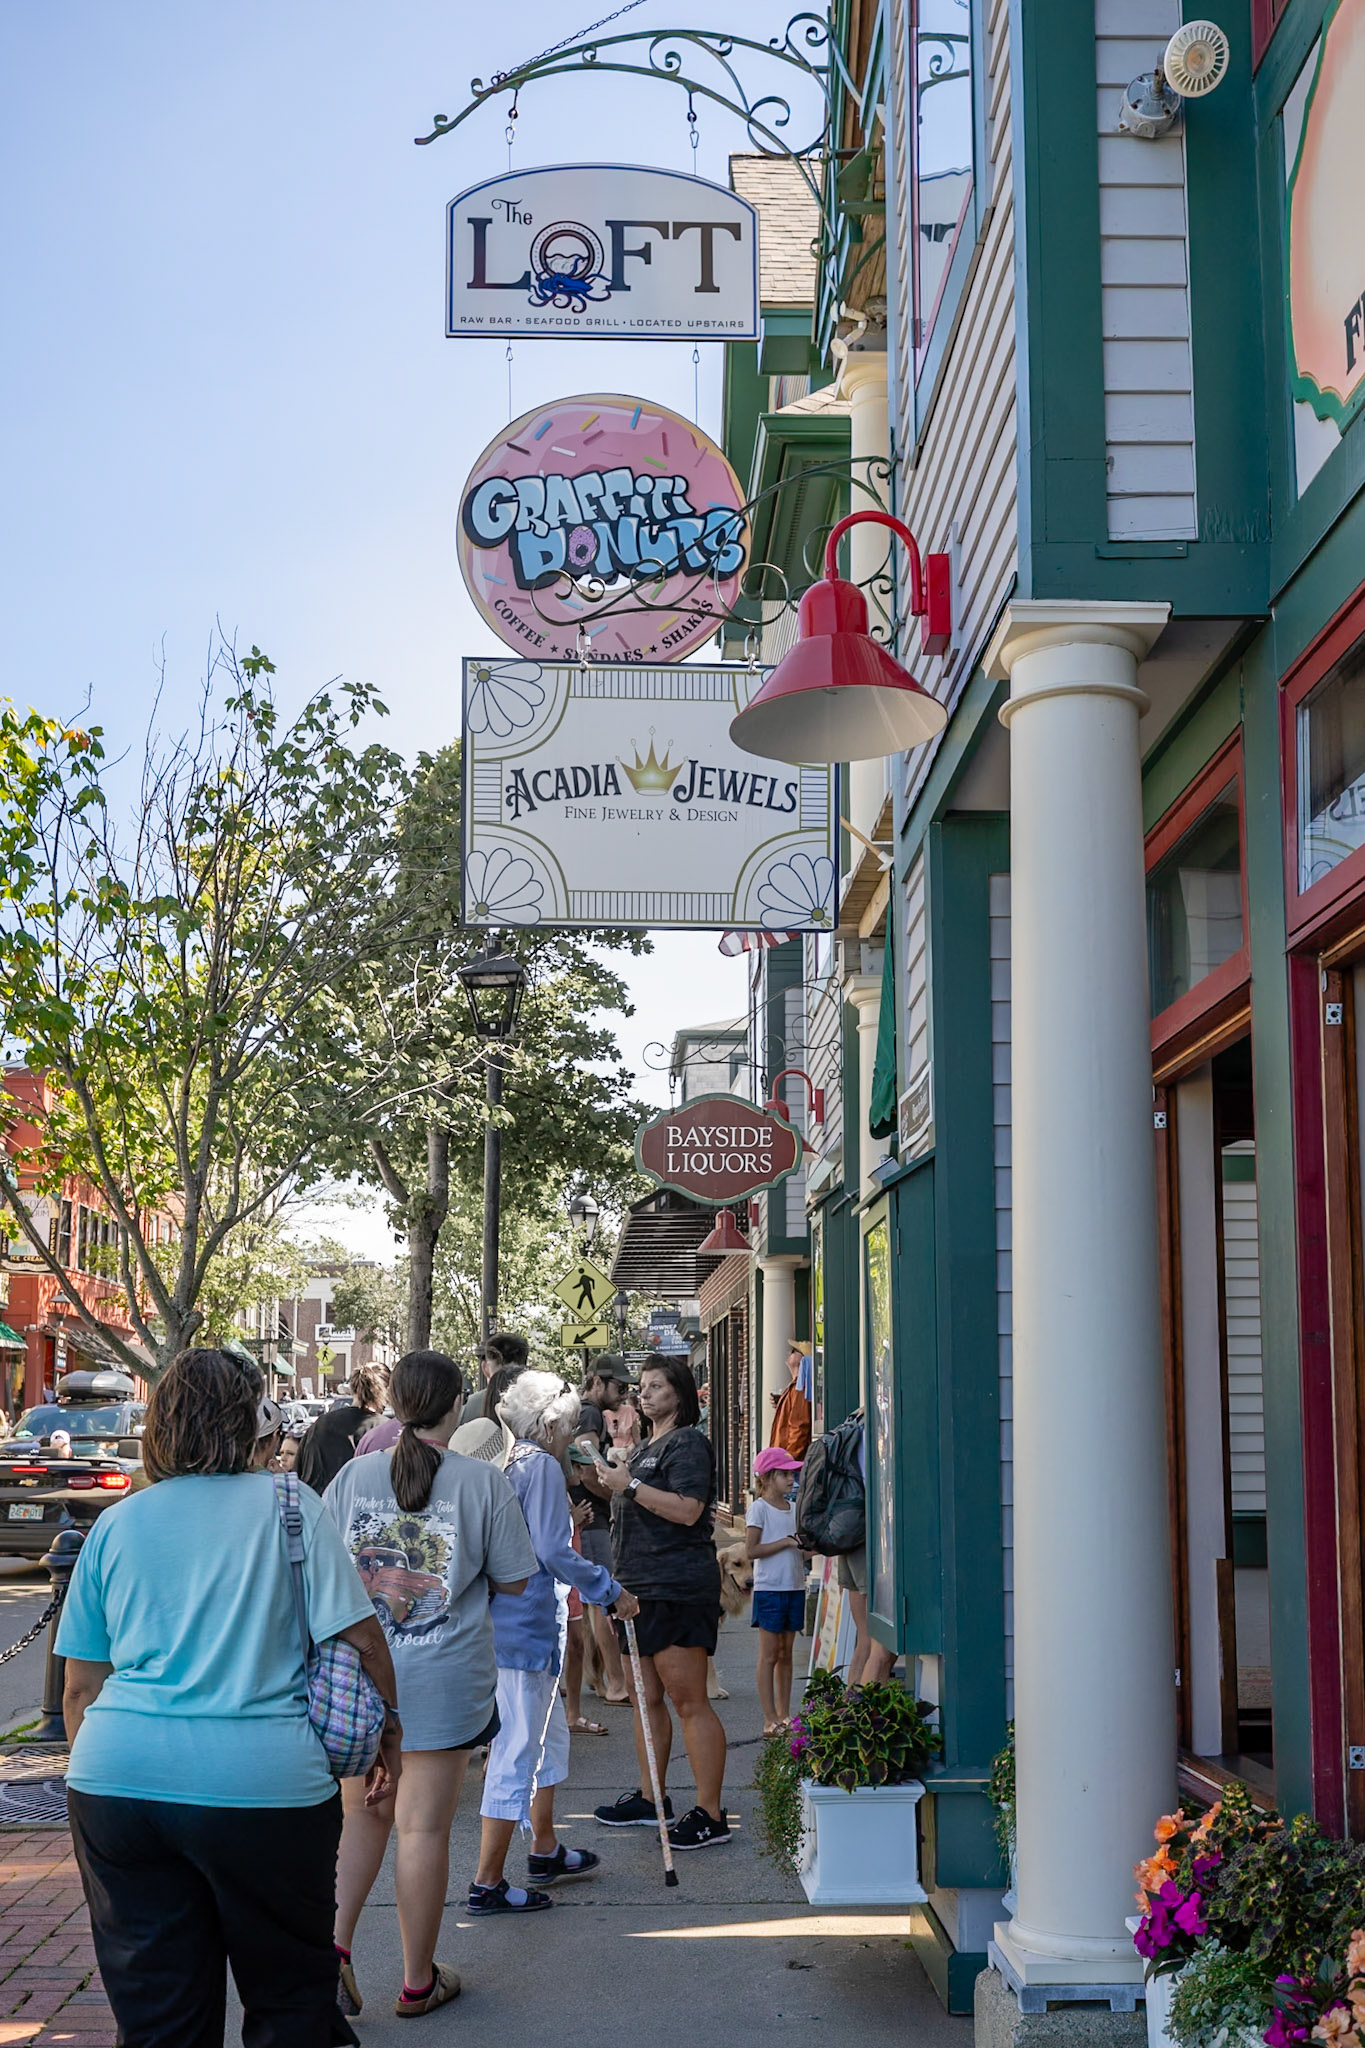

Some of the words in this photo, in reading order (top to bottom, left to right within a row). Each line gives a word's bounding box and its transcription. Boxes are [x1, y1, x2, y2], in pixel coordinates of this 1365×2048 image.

[491, 199, 533, 226] The
[460, 316, 484, 324] RAW
[489, 316, 512, 324] BAR
[525, 317, 581, 326] SEAFOOD
[586, 318, 620, 326] GRILL
[629, 319, 682, 327] LOCATED
[687, 320, 744, 328] UPSTAIRS
[494, 599, 546, 648] COFFEE
[505, 764, 622, 821] ACADIA
[673, 760, 798, 813] JEWELS
[564, 806, 597, 819] FINE
[601, 807, 664, 822] JEWELRY
[669, 808, 681, 821] &
[687, 808, 738, 822] DESIGN
[667, 1126, 773, 1148] BAYSIDE
[667, 1153, 772, 1175] LIQUORS
